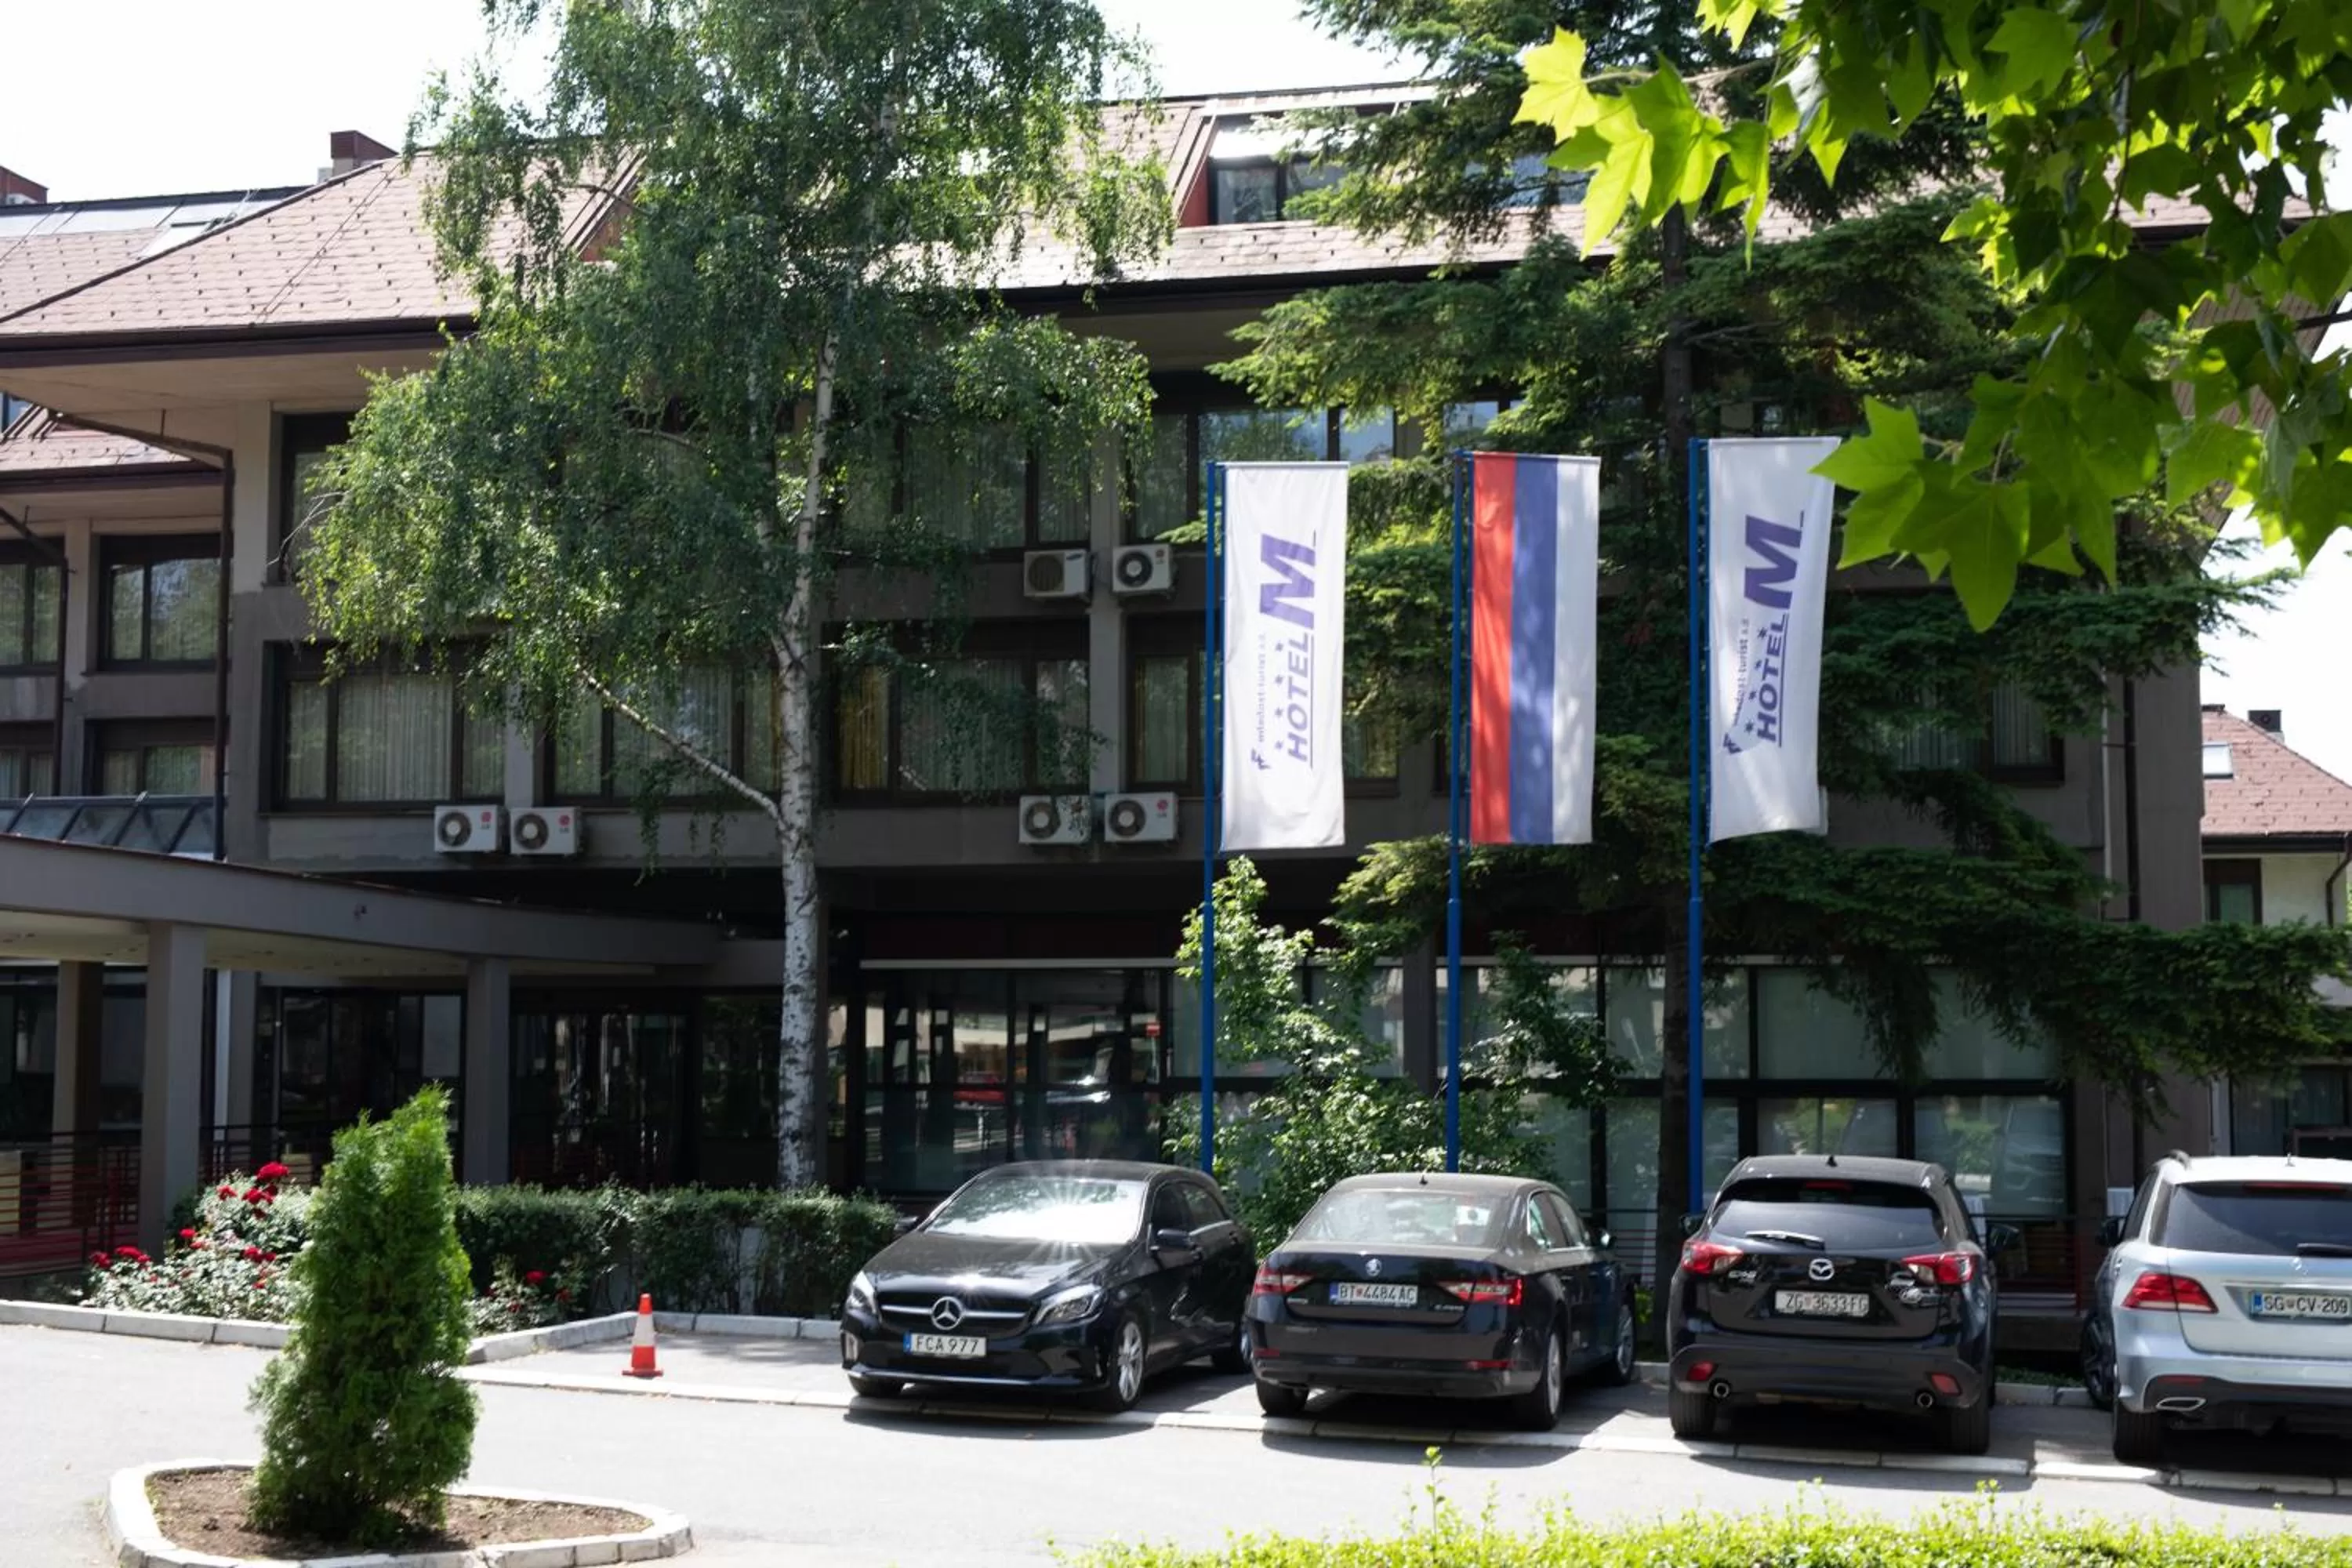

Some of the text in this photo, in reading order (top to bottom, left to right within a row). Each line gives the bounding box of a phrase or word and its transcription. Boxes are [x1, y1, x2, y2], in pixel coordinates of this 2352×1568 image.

[1259, 533, 1316, 763] HOTEL M
[1744, 514, 1802, 742] HOTEL M
[916, 1334, 979, 1353] FCA 977
[2264, 1294, 2348, 1314] SG CV-209
